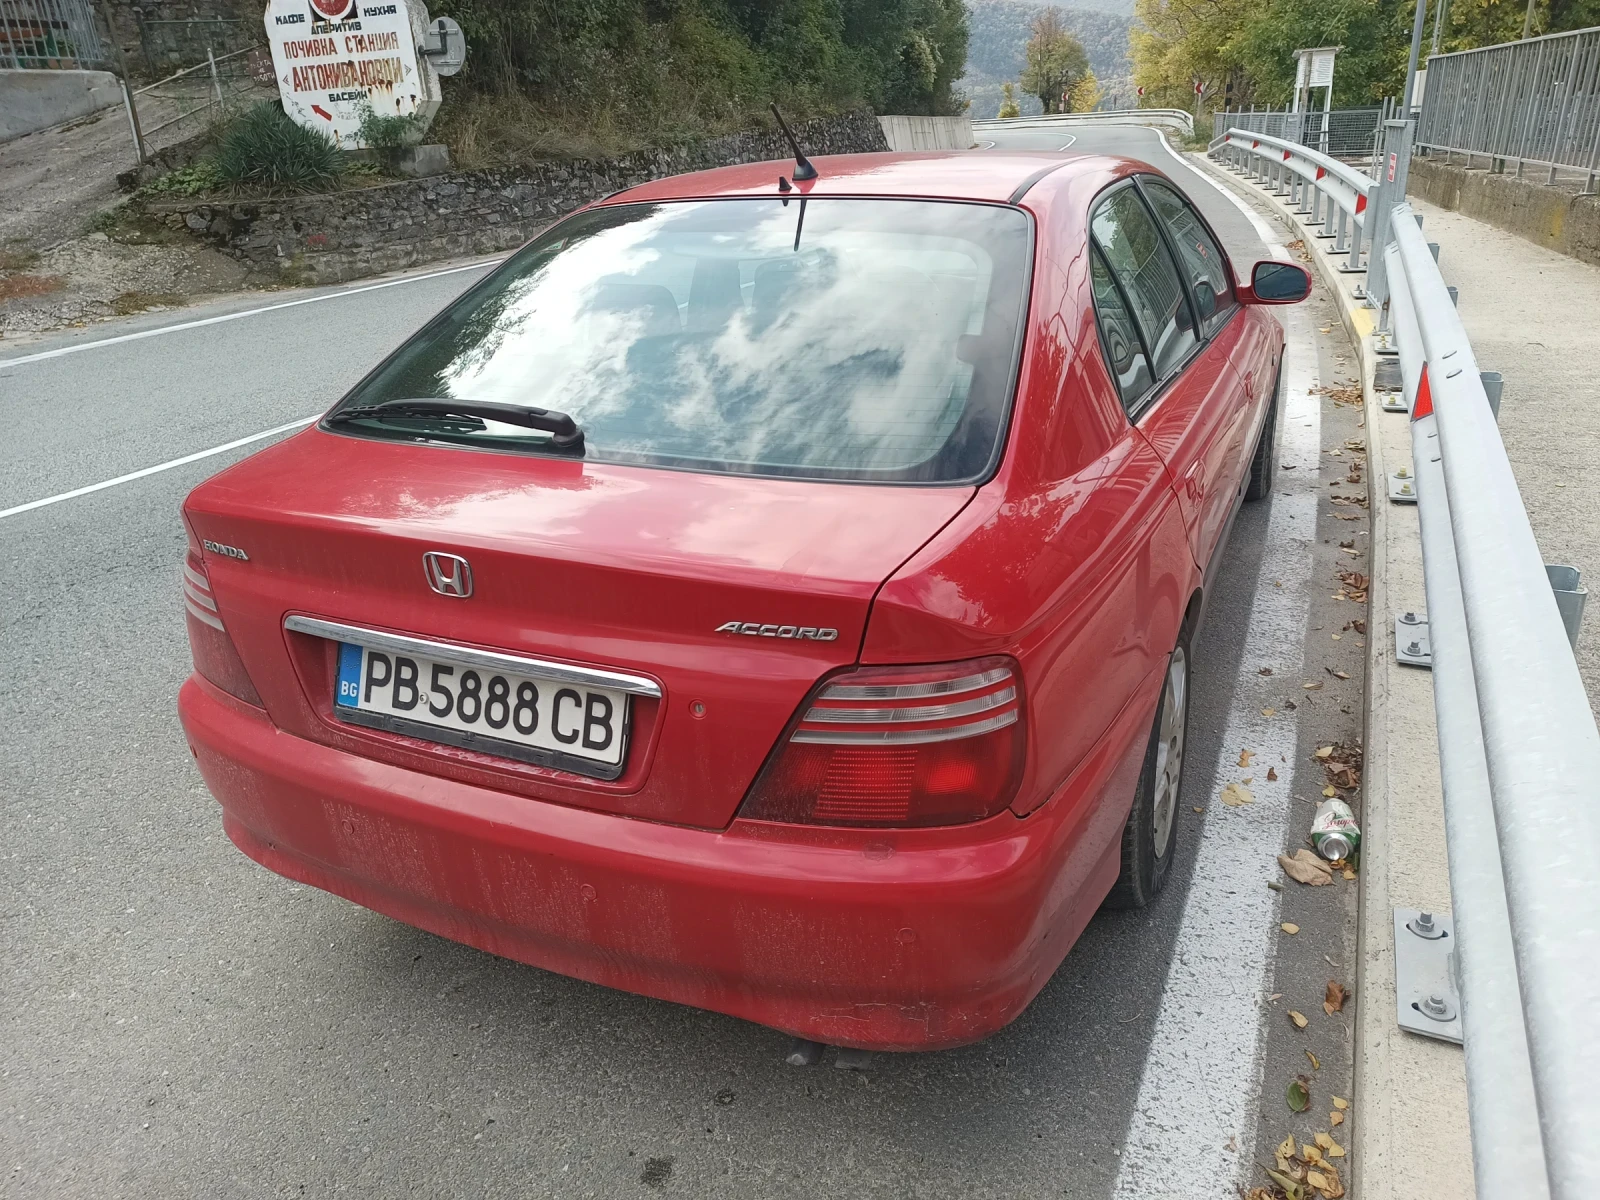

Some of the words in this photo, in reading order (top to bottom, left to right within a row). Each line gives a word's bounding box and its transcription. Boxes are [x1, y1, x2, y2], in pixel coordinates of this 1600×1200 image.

[275, 13, 305, 25] КАФЕ
[363, 5, 397, 17] КУХНЯ
[311, 21, 362, 35] АПЕРИТИВ
[283, 37, 338, 59] ПОЧИВНА
[344, 31, 400, 54] СТАНЦИЯ
[328, 89, 368, 102] БАСЕЙН
[203, 539, 249, 560] HONDA
[714, 621, 838, 641] ACCORD
[341, 680, 358, 698] BG
[428, 663, 539, 735] 5888
